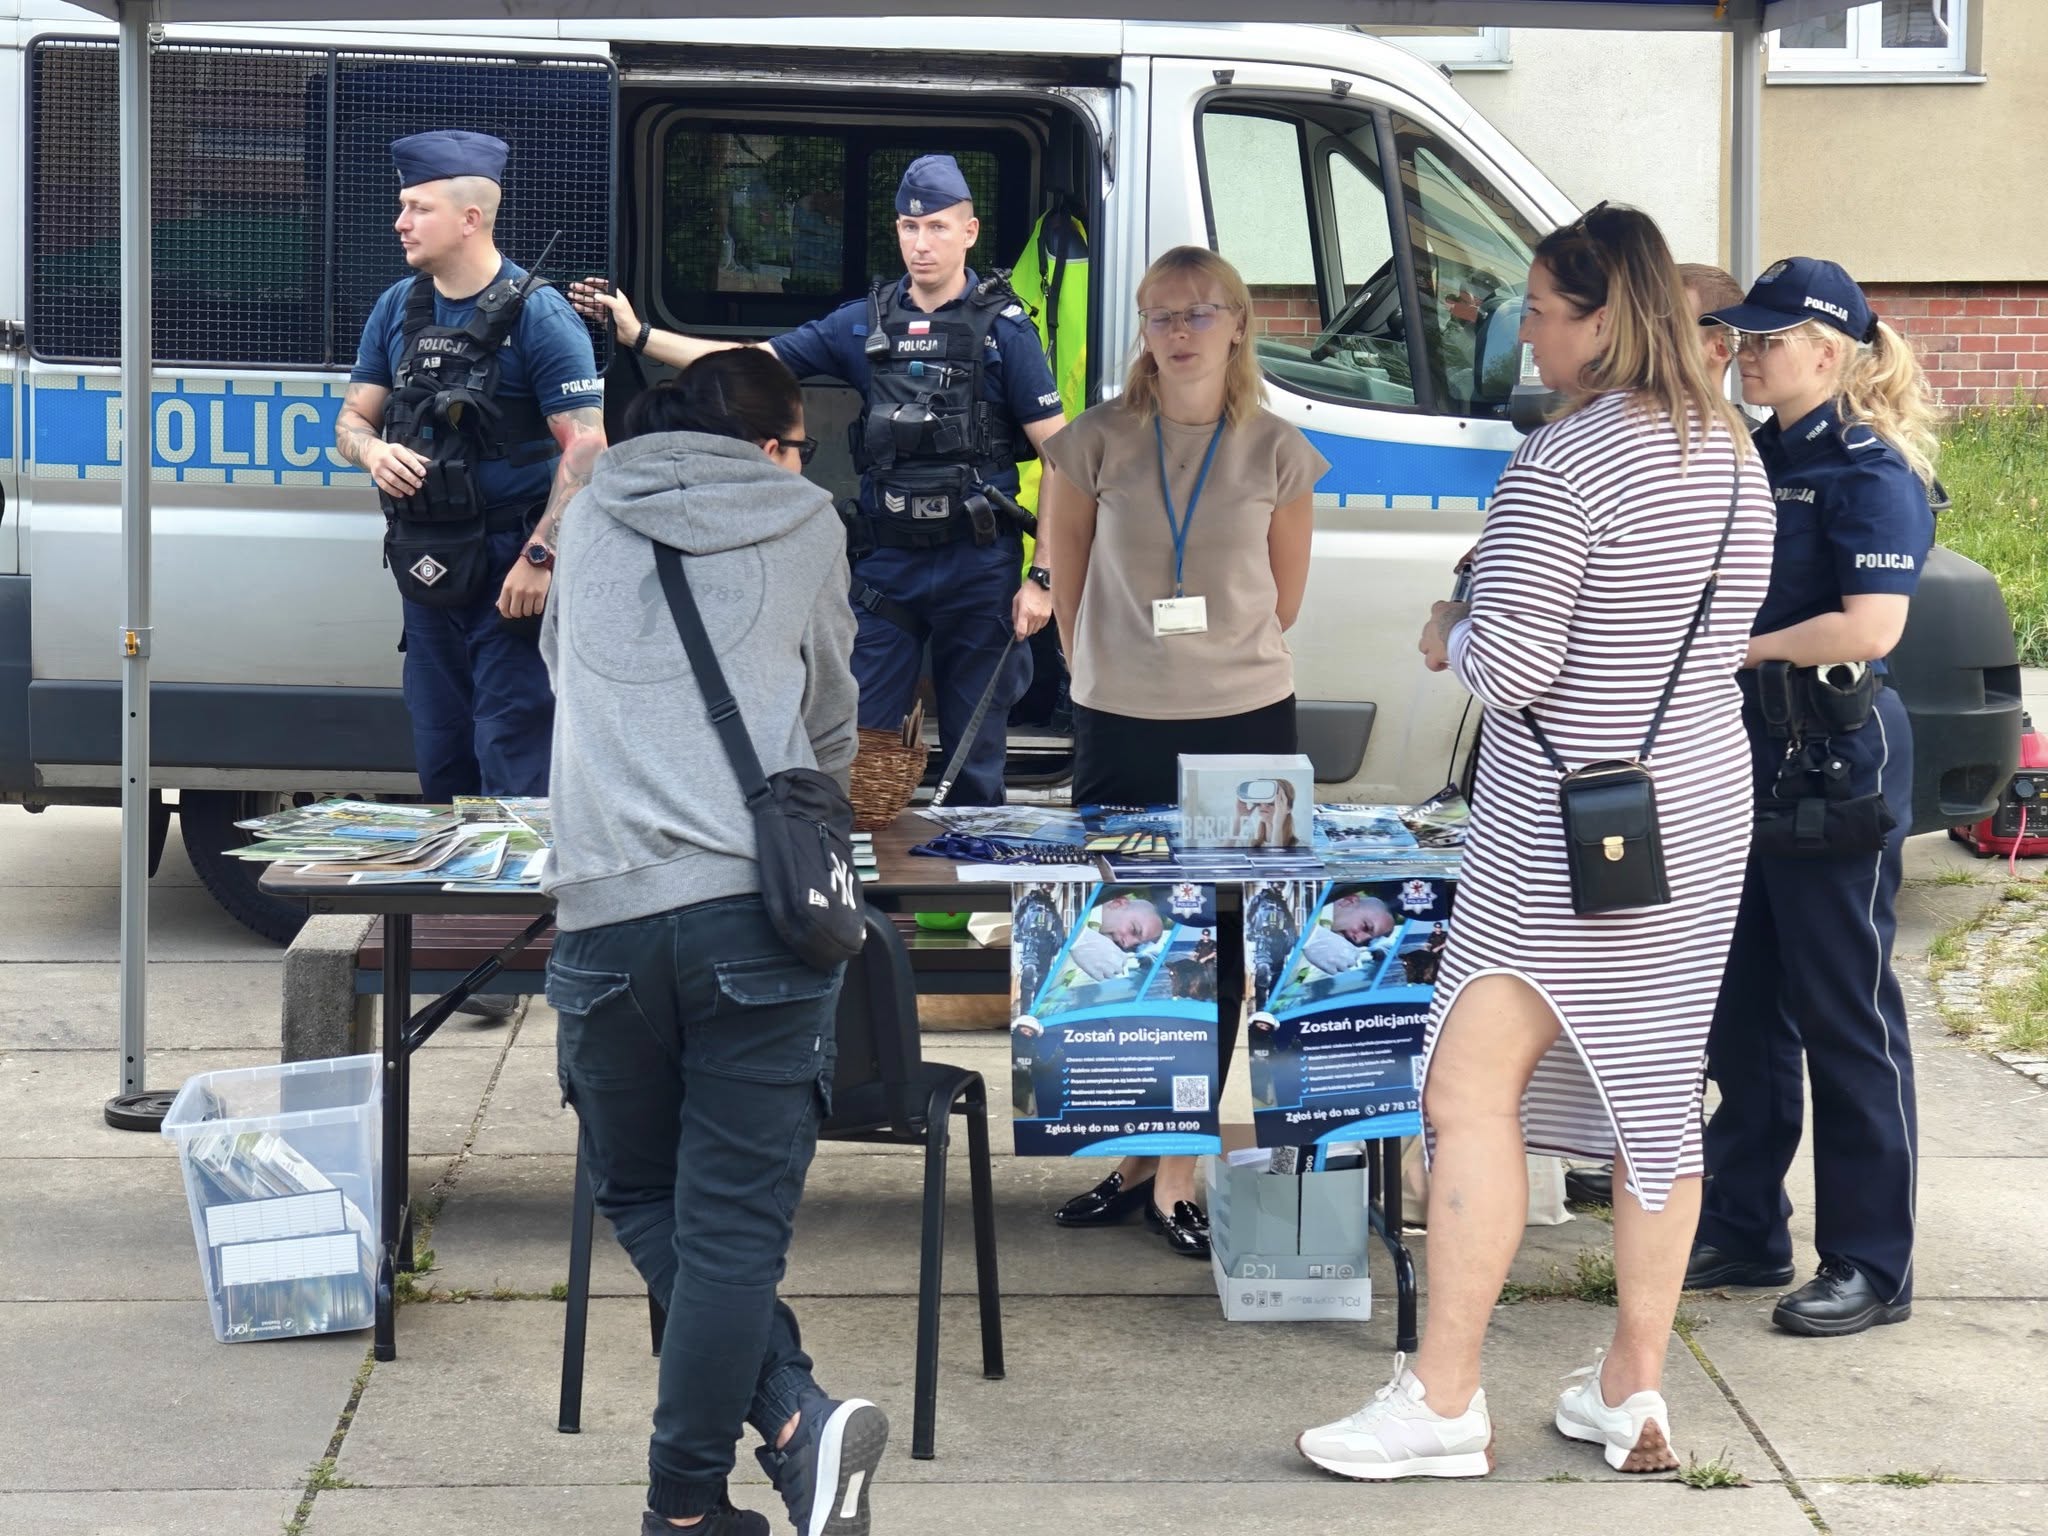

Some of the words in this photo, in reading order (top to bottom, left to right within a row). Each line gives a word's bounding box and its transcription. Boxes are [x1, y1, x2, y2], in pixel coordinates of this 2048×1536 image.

[1803, 296, 1848, 321] POLICJA
[898, 339, 938, 352] POLICJA
[1038, 391, 1060, 407] POLIC
[1855, 553, 1915, 569] POLICJA
[1300, 1017, 1352, 1034] Zostań
[1355, 1012, 1430, 1032] policjante
[1063, 1028, 1116, 1044] Zostań
[1118, 1028, 1208, 1046] policjantem
[1313, 1110, 1328, 1121] się
[1329, 1107, 1343, 1117] do
[1344, 1107, 1361, 1117] nas
[1378, 1103, 1391, 1113] 47
[1392, 1102, 1405, 1112] 78
[1406, 1100, 1418, 1110] 12
[1045, 1123, 1072, 1136] Zgłoś
[1072, 1123, 1087, 1135] się
[1088, 1122, 1101, 1133] do
[1103, 1124, 1120, 1133] nas
[1137, 1121, 1150, 1131] 47
[1151, 1121, 1164, 1131] 78
[1166, 1121, 1176, 1131] 12
[1177, 1120, 1200, 1131] 000
